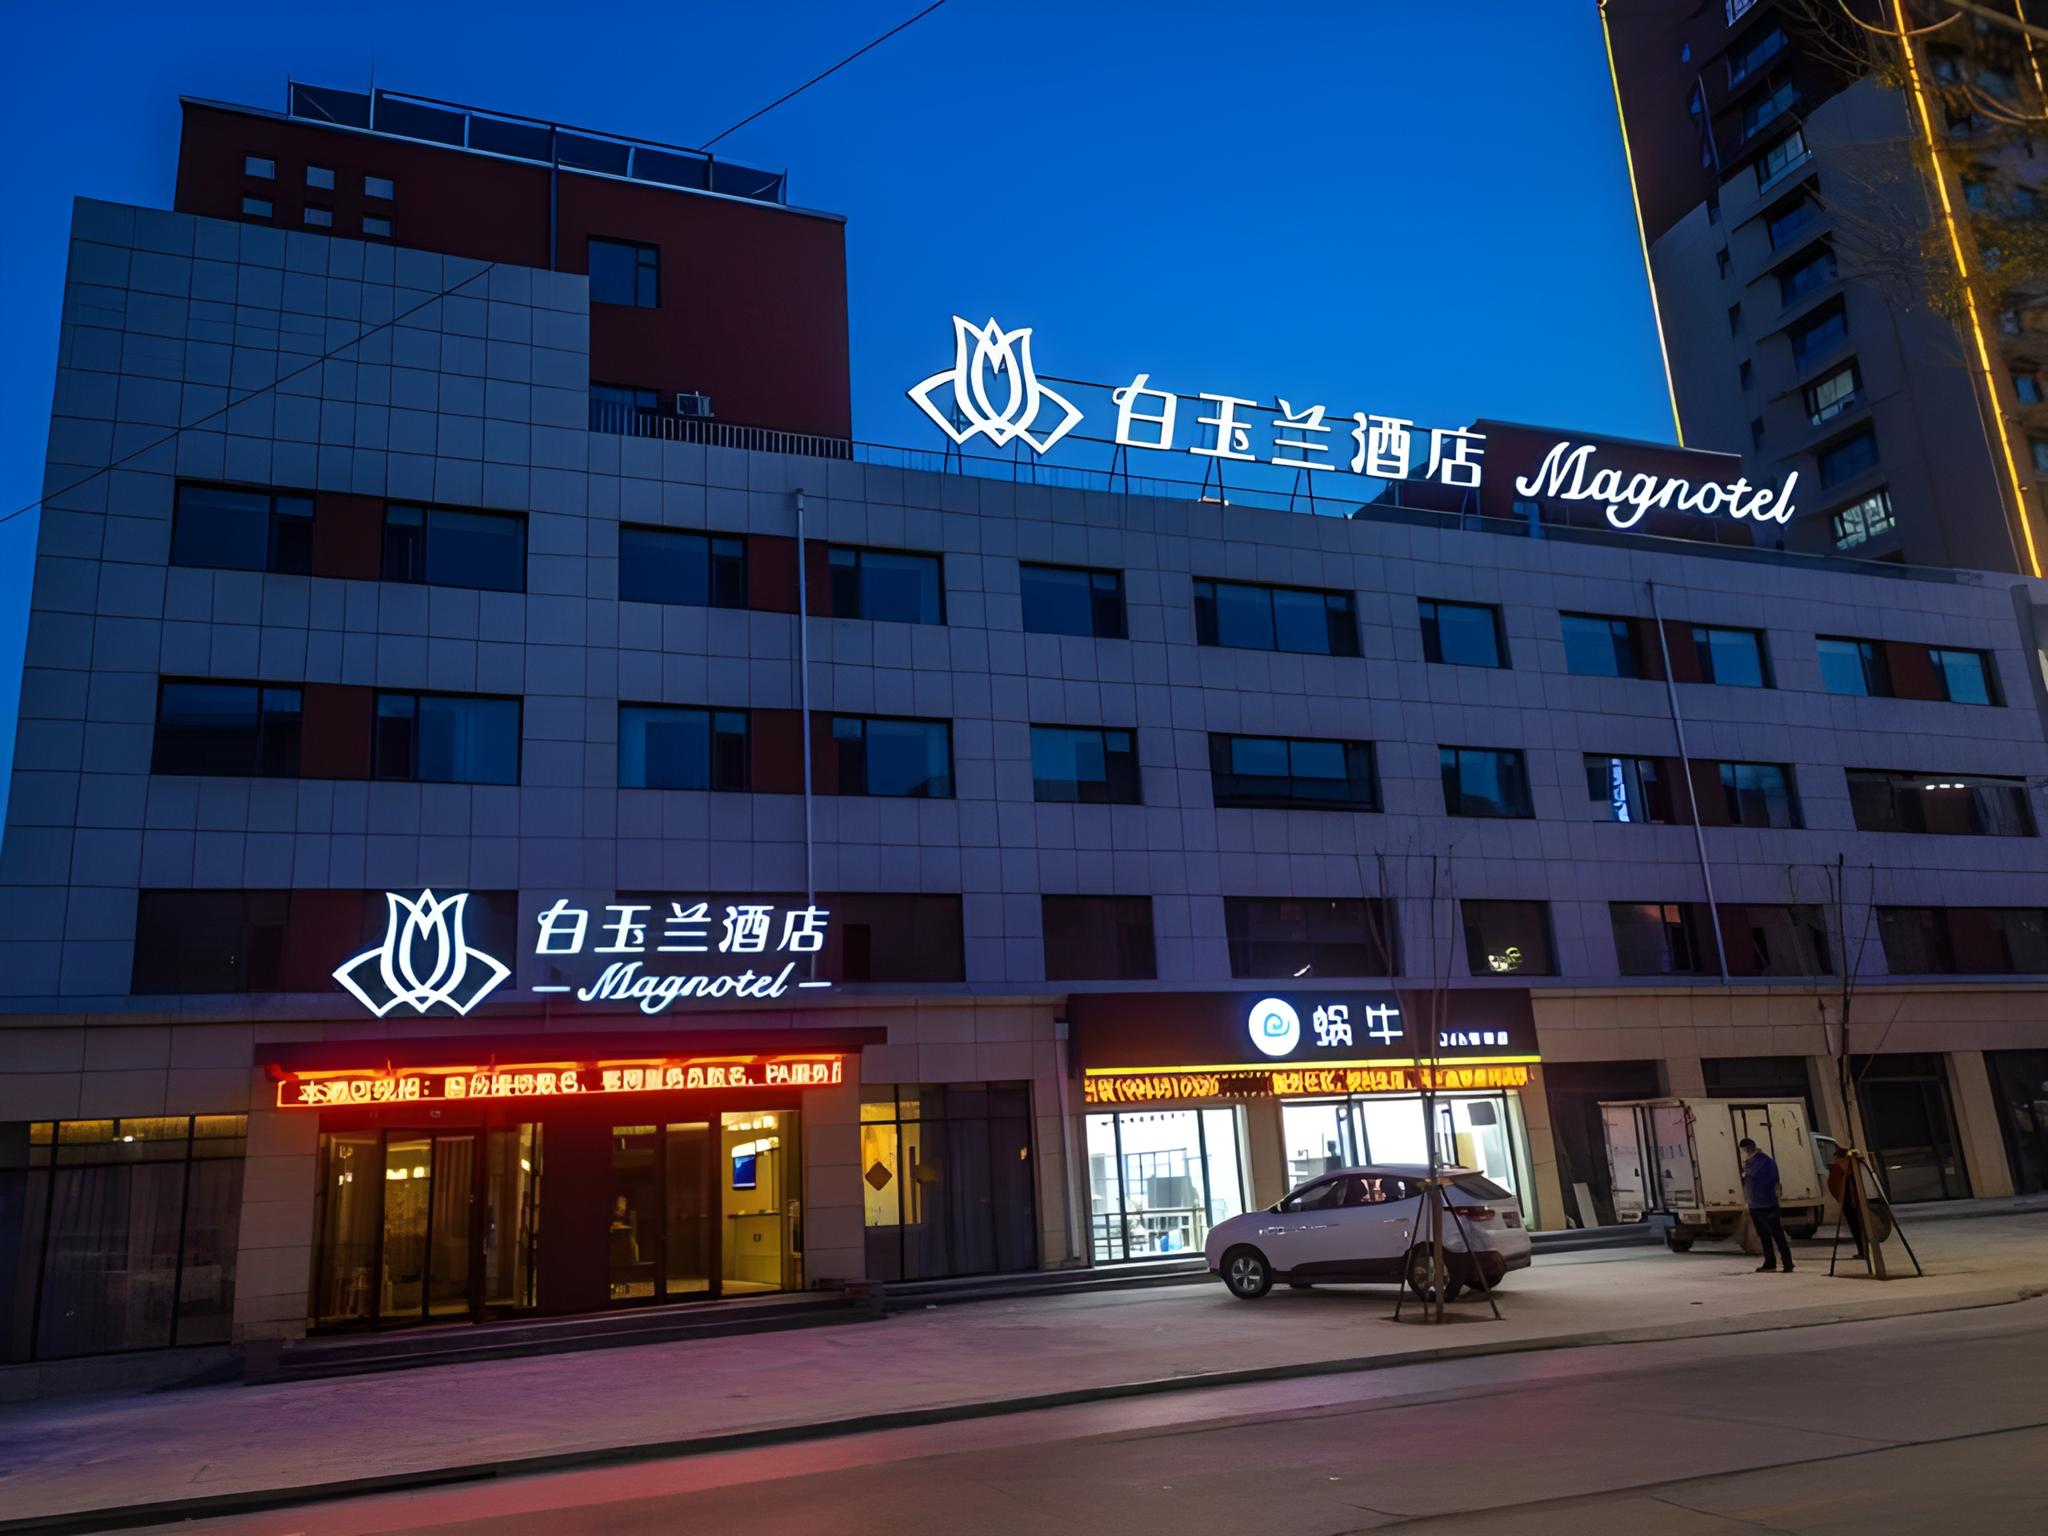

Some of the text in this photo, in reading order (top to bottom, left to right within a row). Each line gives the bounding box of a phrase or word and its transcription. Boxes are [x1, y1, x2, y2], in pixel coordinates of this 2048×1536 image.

[1112, 373, 1487, 487] 白玉兰酒店
[1515, 441, 1799, 528] Magnotel
[535, 898, 830, 954] 白玉兰酒店
[577, 961, 795, 1014] Magnotel
[1312, 1003, 1404, 1047] 蜗牛
